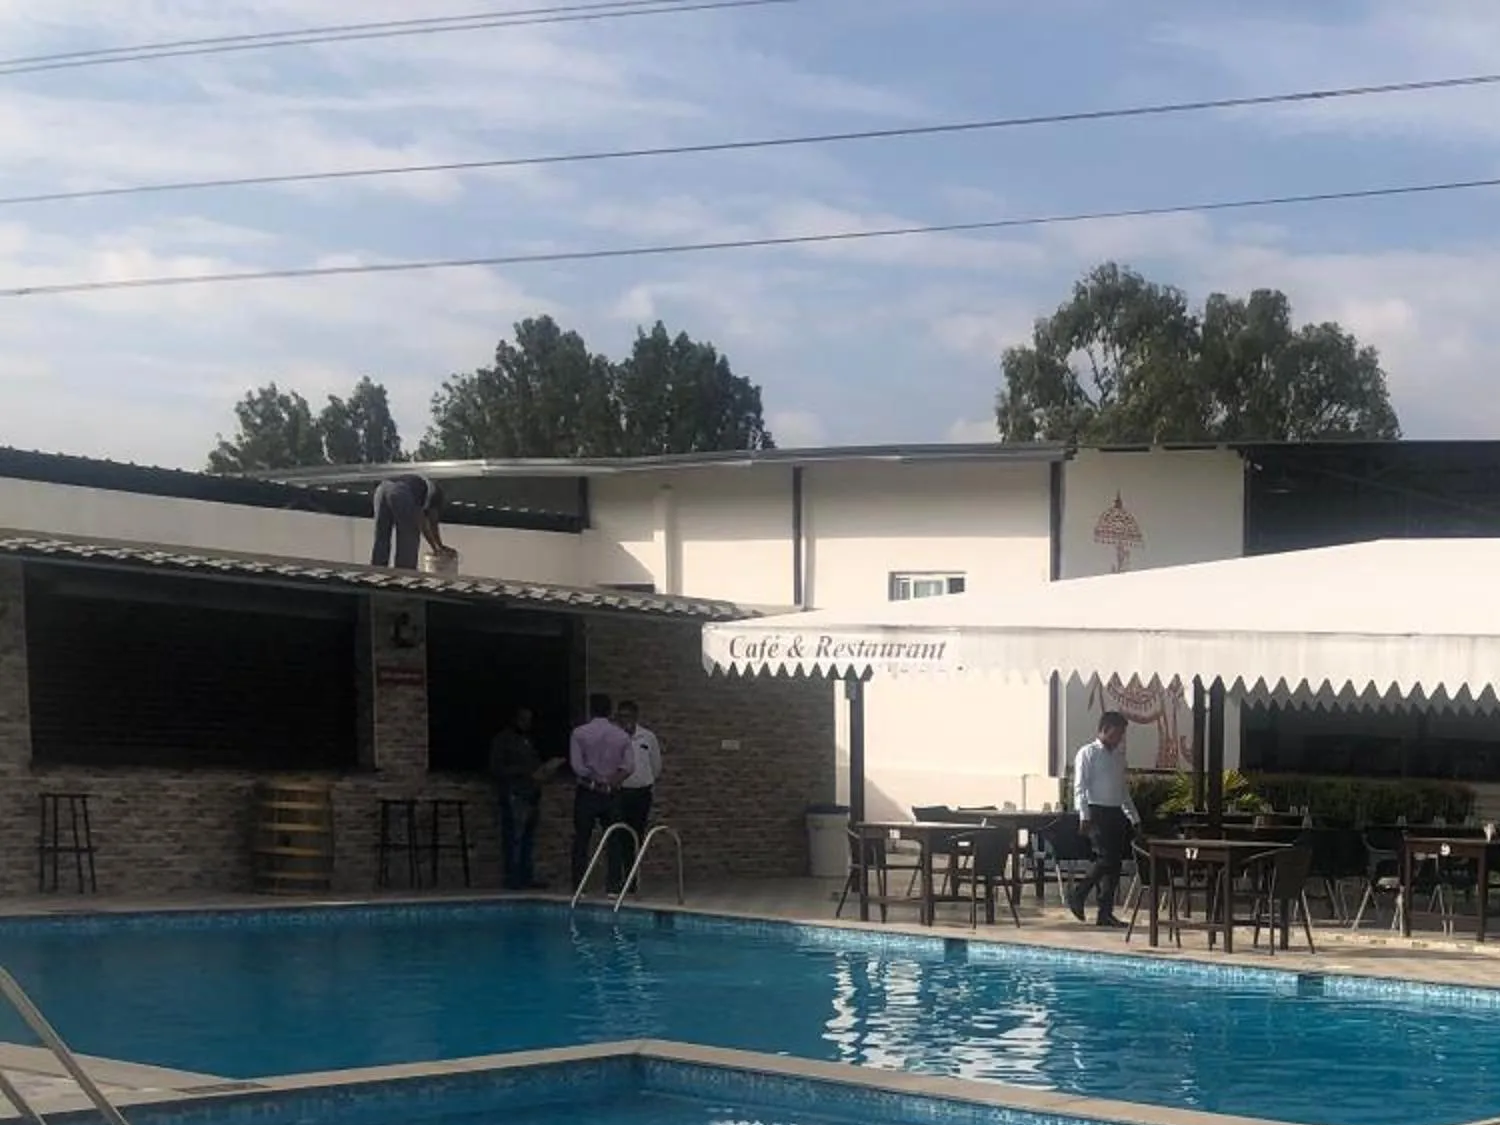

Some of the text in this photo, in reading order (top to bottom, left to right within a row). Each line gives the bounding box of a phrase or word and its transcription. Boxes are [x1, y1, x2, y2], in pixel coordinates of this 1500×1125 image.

[728, 634, 948, 662] Café & Restaurant
